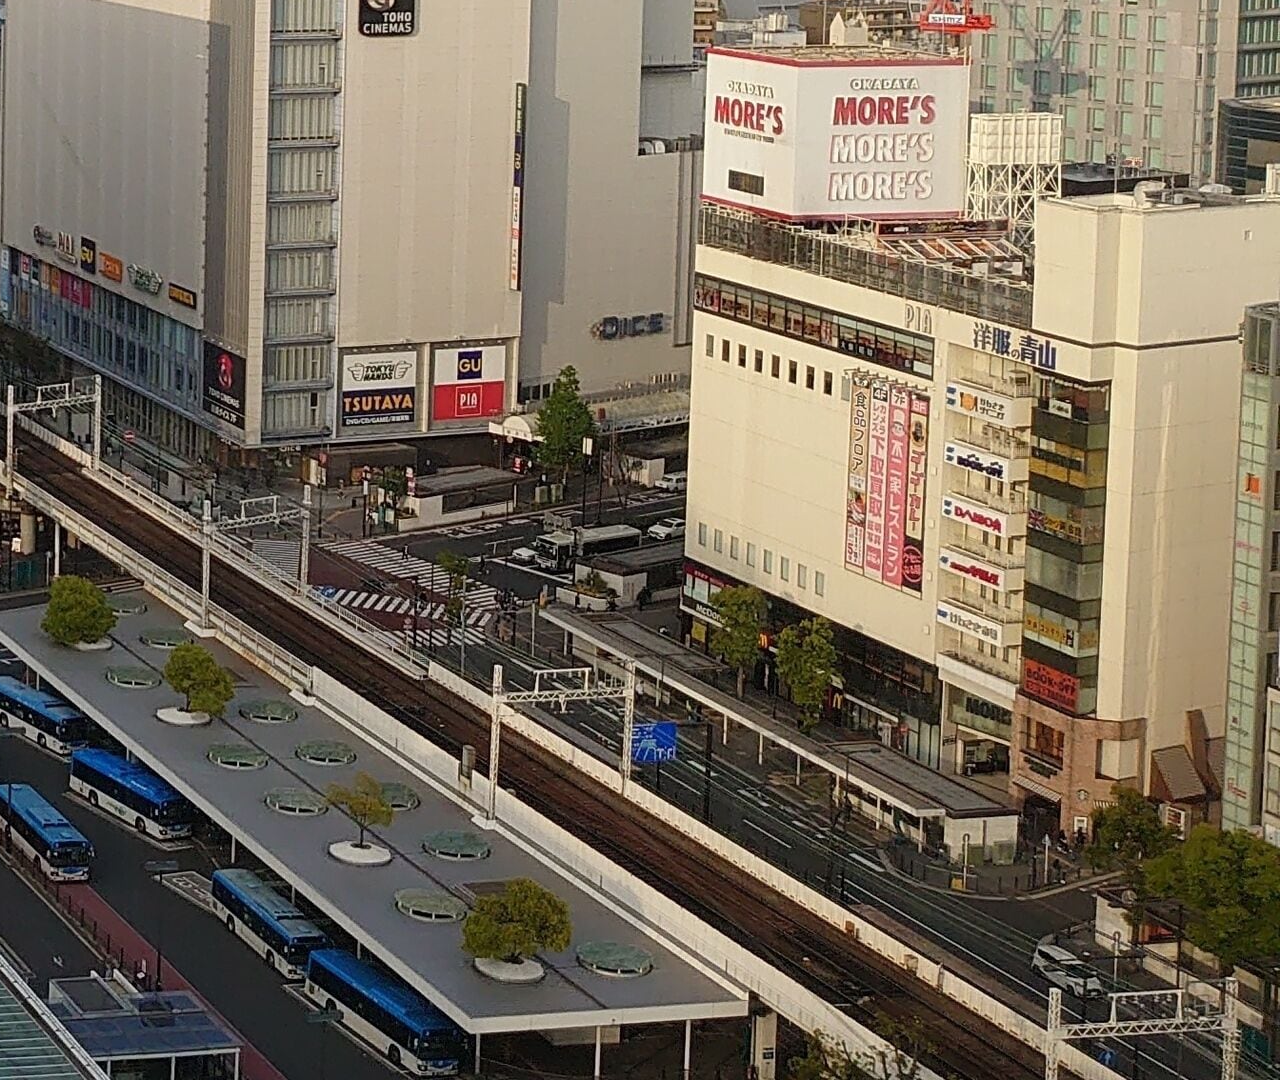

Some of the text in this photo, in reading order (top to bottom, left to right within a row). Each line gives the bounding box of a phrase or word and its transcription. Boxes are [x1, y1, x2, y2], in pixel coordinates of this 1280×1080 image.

[382, 12, 412, 22] TOHO
[363, 22, 412, 34] CINEMAS
[727, 80, 774, 99] OKADAYA
[850, 78, 920, 91] OKADAYA
[714, 95, 784, 136] MORE'S
[832, 95, 936, 126] MORE'S
[830, 132, 934, 164] MORE'S
[828, 169, 933, 202] MORE'S
[905, 303, 933, 334] PIA
[973, 321, 1058, 370] 洋服の青山
[364, 364, 395, 373] TOKYU
[458, 358, 481, 372] GU
[364, 372, 393, 382] HANDS
[343, 393, 413, 413] TSUTAYA
[460, 392, 478, 407] PIA
[874, 389, 887, 400] 4F
[894, 394, 906, 405] 7F
[853, 391, 868, 471] 食品フロア
[908, 450, 926, 532] ゴーゴーカレー
[886, 439, 904, 577] 不二家レストラン
